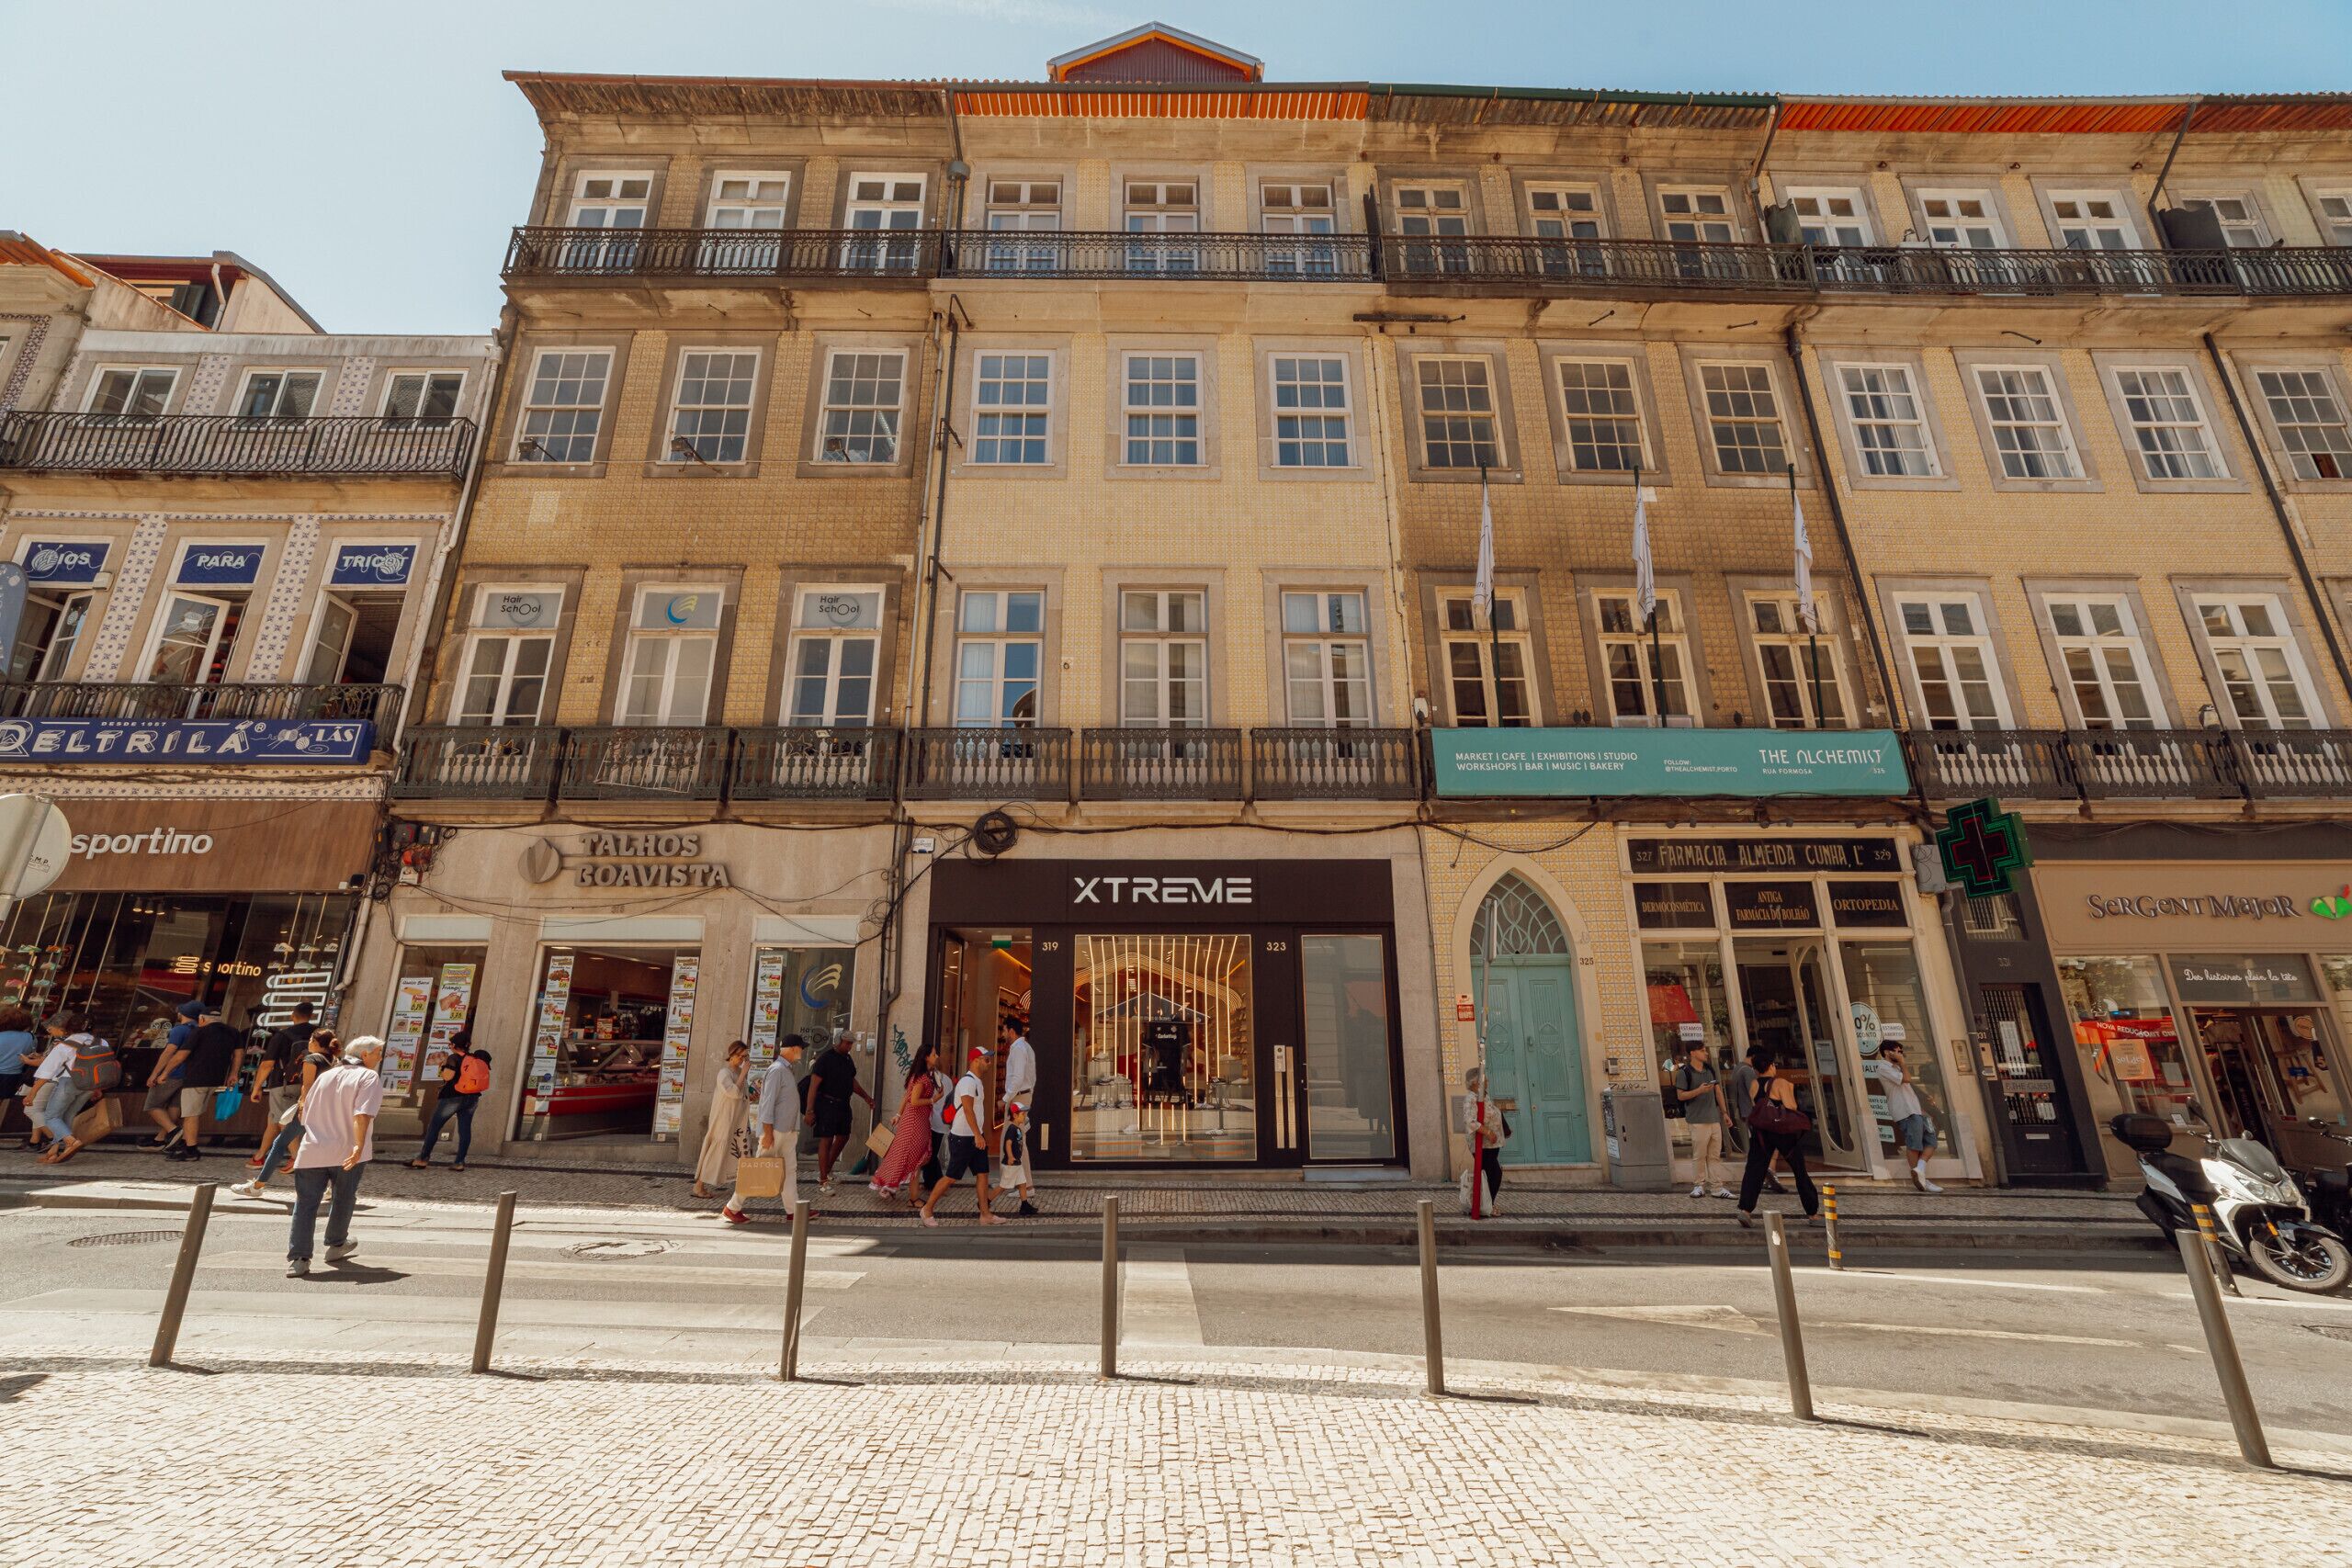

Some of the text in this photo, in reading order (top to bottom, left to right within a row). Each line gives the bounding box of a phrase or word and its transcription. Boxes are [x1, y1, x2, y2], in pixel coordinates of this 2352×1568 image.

[197, 553, 245, 568] PARA
[343, 555, 409, 568] TRICOT
[503, 595, 523, 604] Hair
[820, 595, 840, 604] Hair
[501, 603, 541, 615] School
[819, 603, 860, 615] School
[315, 726, 355, 742] LÃS
[1455, 752, 1638, 761] MARKET CAFE EXHIBITIONS STUDIO
[1758, 749, 1882, 764] THE ALCHEMIST
[1456, 762, 1624, 771] WORKSHOPS BAR MUSIC BAKERY
[71, 828, 214, 860] sportino
[578, 834, 700, 858] TALHOS
[1636, 851, 1652, 862] 327
[1658, 844, 1727, 866] FARMACIA
[1738, 844, 1795, 866] ALMEIDA
[1874, 851, 1892, 861] 329
[574, 863, 733, 888] BOAVISTA
[1073, 877, 1252, 904] XTREME
[1758, 891, 1782, 903] ANTIGA
[1642, 899, 1706, 913] DERMOCOSMÉTICA
[1833, 898, 1899, 912] ORTOPEDIA
[1736, 906, 1770, 920] FARMÁCIA
[1042, 942, 1058, 951] 319
[1266, 942, 1286, 951] 323
[1579, 957, 1594, 965] 325
[203, 961, 262, 976] sortino
[2184, 968, 2203, 981] Des
[2204, 968, 2242, 981] histoires
[1854, 1014, 1875, 1031] 0%
[2097, 1021, 2116, 1031] NOVA
